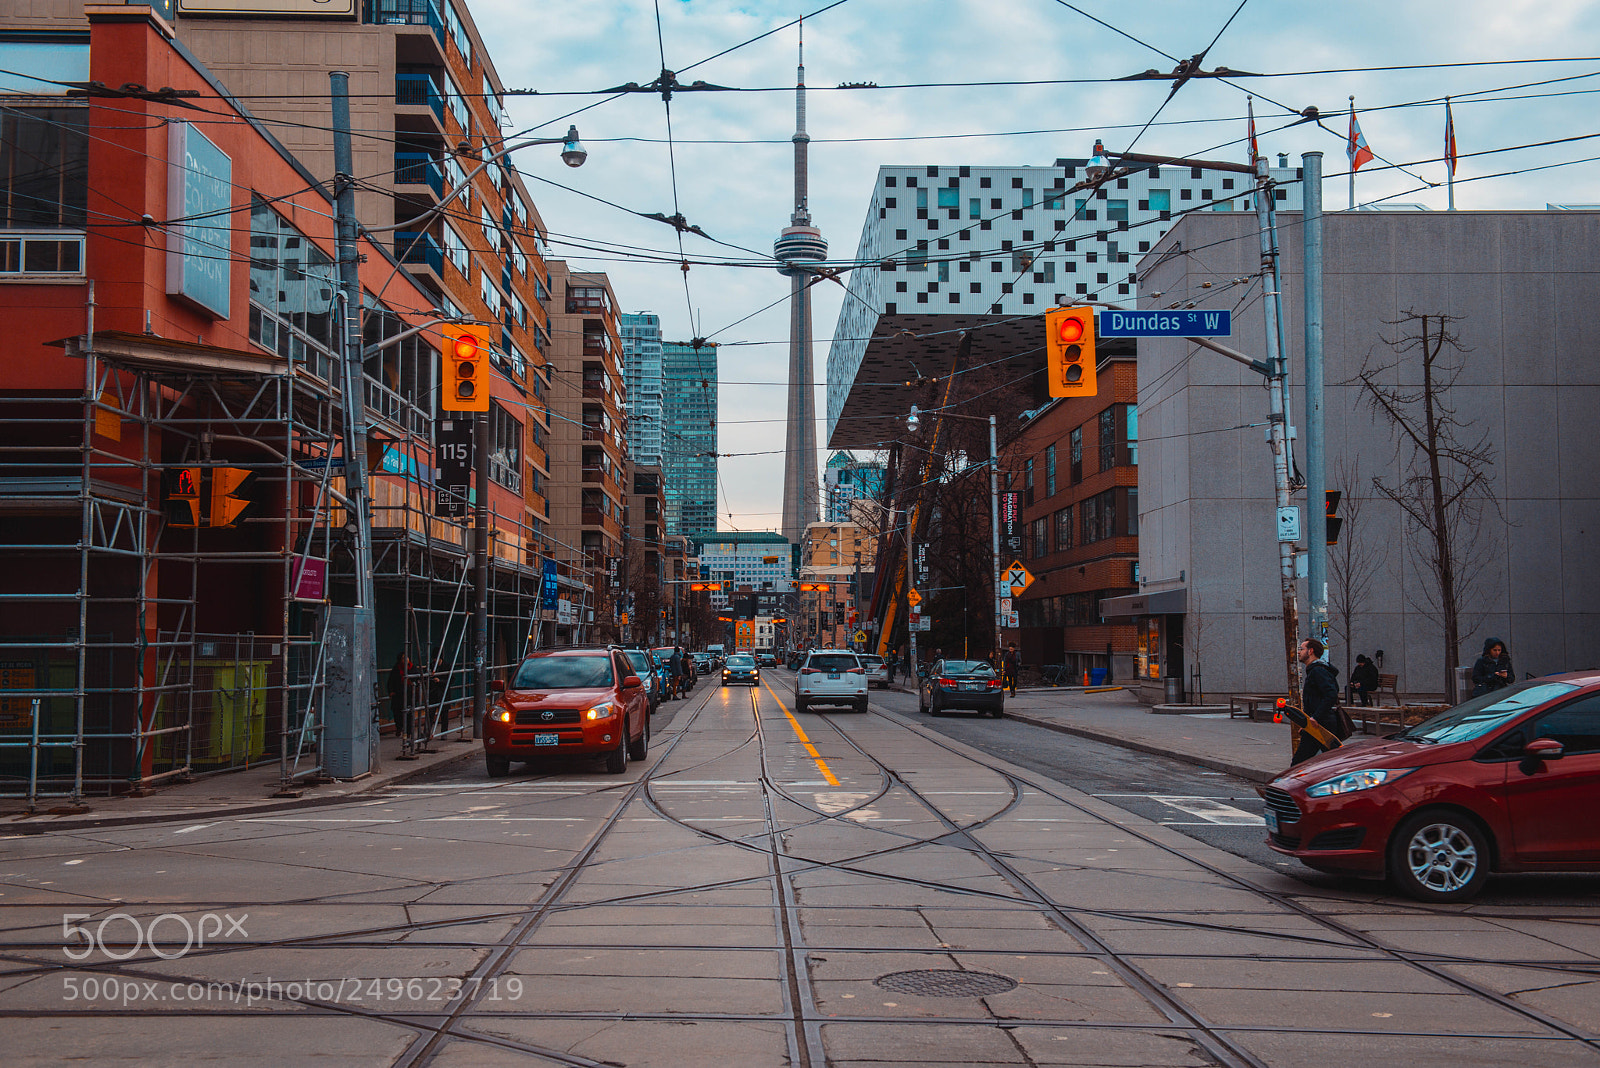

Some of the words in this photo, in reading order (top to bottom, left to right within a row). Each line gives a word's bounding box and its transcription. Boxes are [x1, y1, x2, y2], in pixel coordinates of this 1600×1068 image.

[1112, 313, 1180, 331] Dundas
[1187, 313, 1197, 322] St
[1204, 313, 1219, 330] W
[440, 443, 468, 460] 115
[1002, 492, 1008, 503] TO
